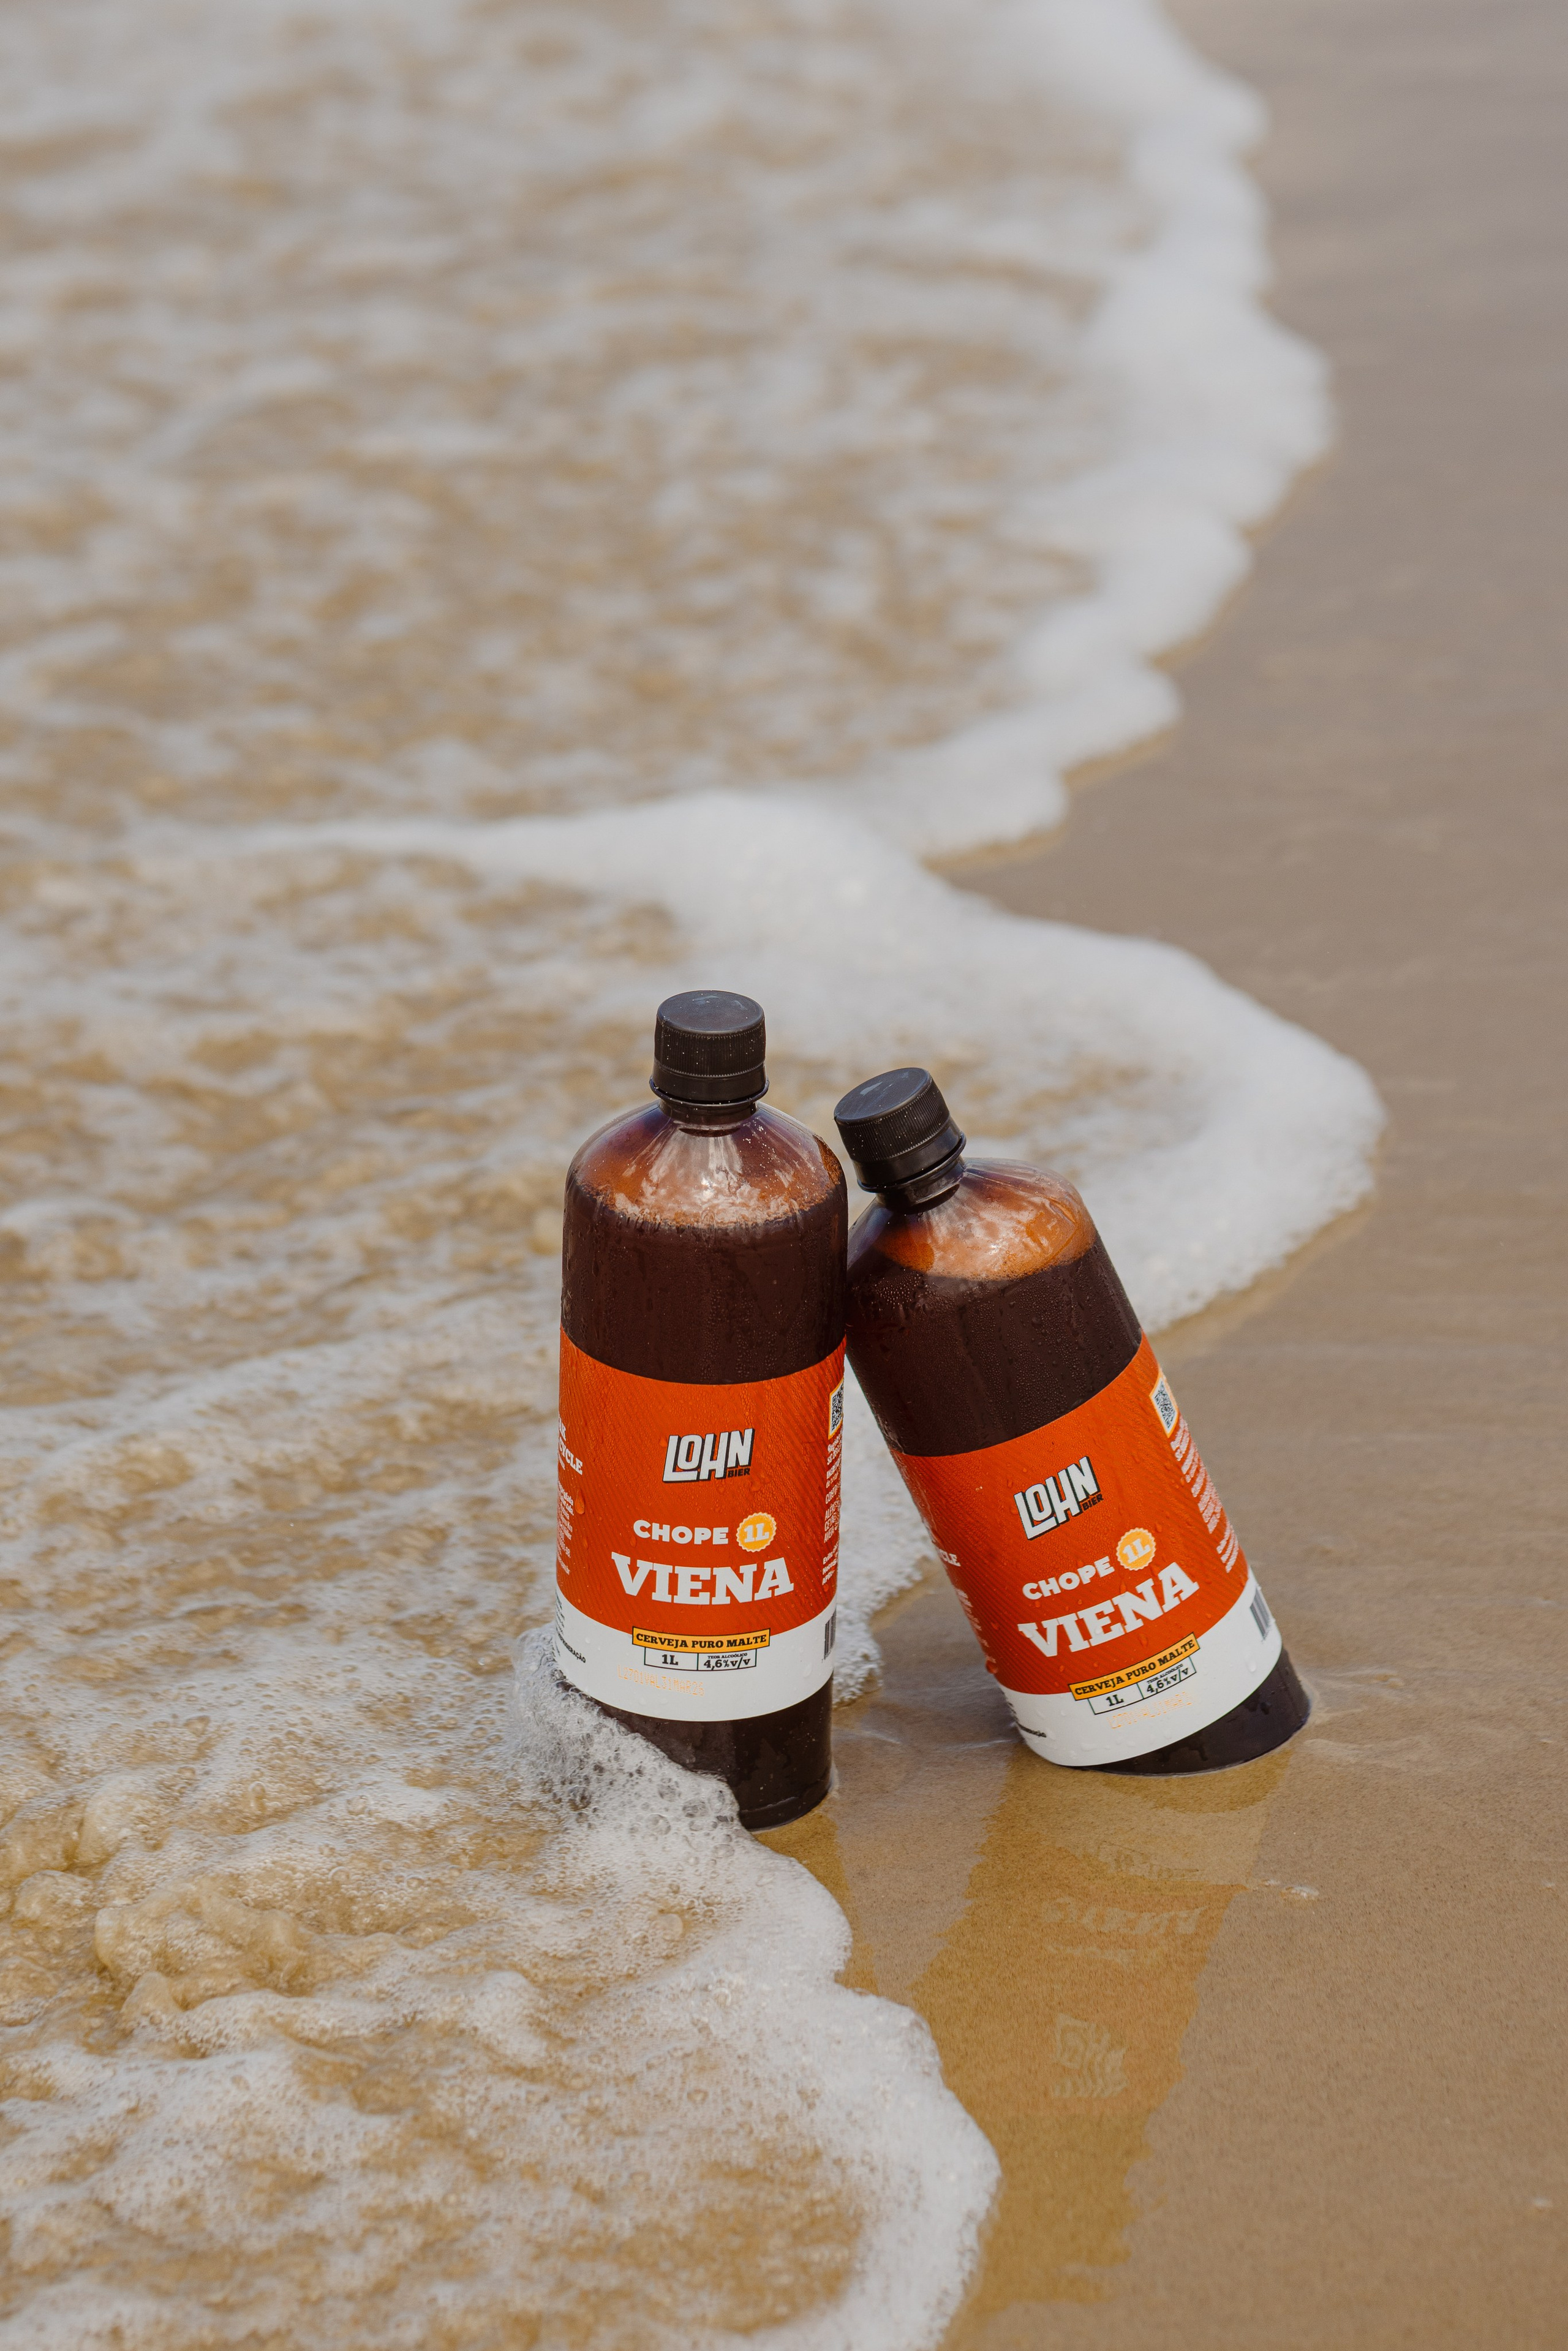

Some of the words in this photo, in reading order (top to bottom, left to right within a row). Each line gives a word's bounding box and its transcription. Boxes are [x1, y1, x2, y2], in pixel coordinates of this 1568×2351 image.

[663, 1428, 755, 1482] LOHN
[726, 1468, 751, 1479] BIER
[1014, 1456, 1101, 1540] LOHN
[1082, 1494, 1104, 1511] BIER
[633, 1519, 729, 1545] CHOPE
[742, 1523, 769, 1543] 1L
[611, 1552, 794, 1606] VIENA
[1022, 1557, 1115, 1600] CHOPE
[1123, 1539, 1152, 1563] 1L
[1018, 1562, 1200, 1657] VIENA
[636, 1633, 689, 1649] CERVEJA
[692, 1640, 724, 1649] PURO
[726, 1634, 767, 1648] MALTE
[662, 1654, 679, 1666] 1L
[1075, 1675, 1125, 1696] CERVEJA
[1125, 1662, 1156, 1680] PURO
[1157, 1639, 1195, 1666] MALTE
[1106, 1694, 1124, 1706] 1L
